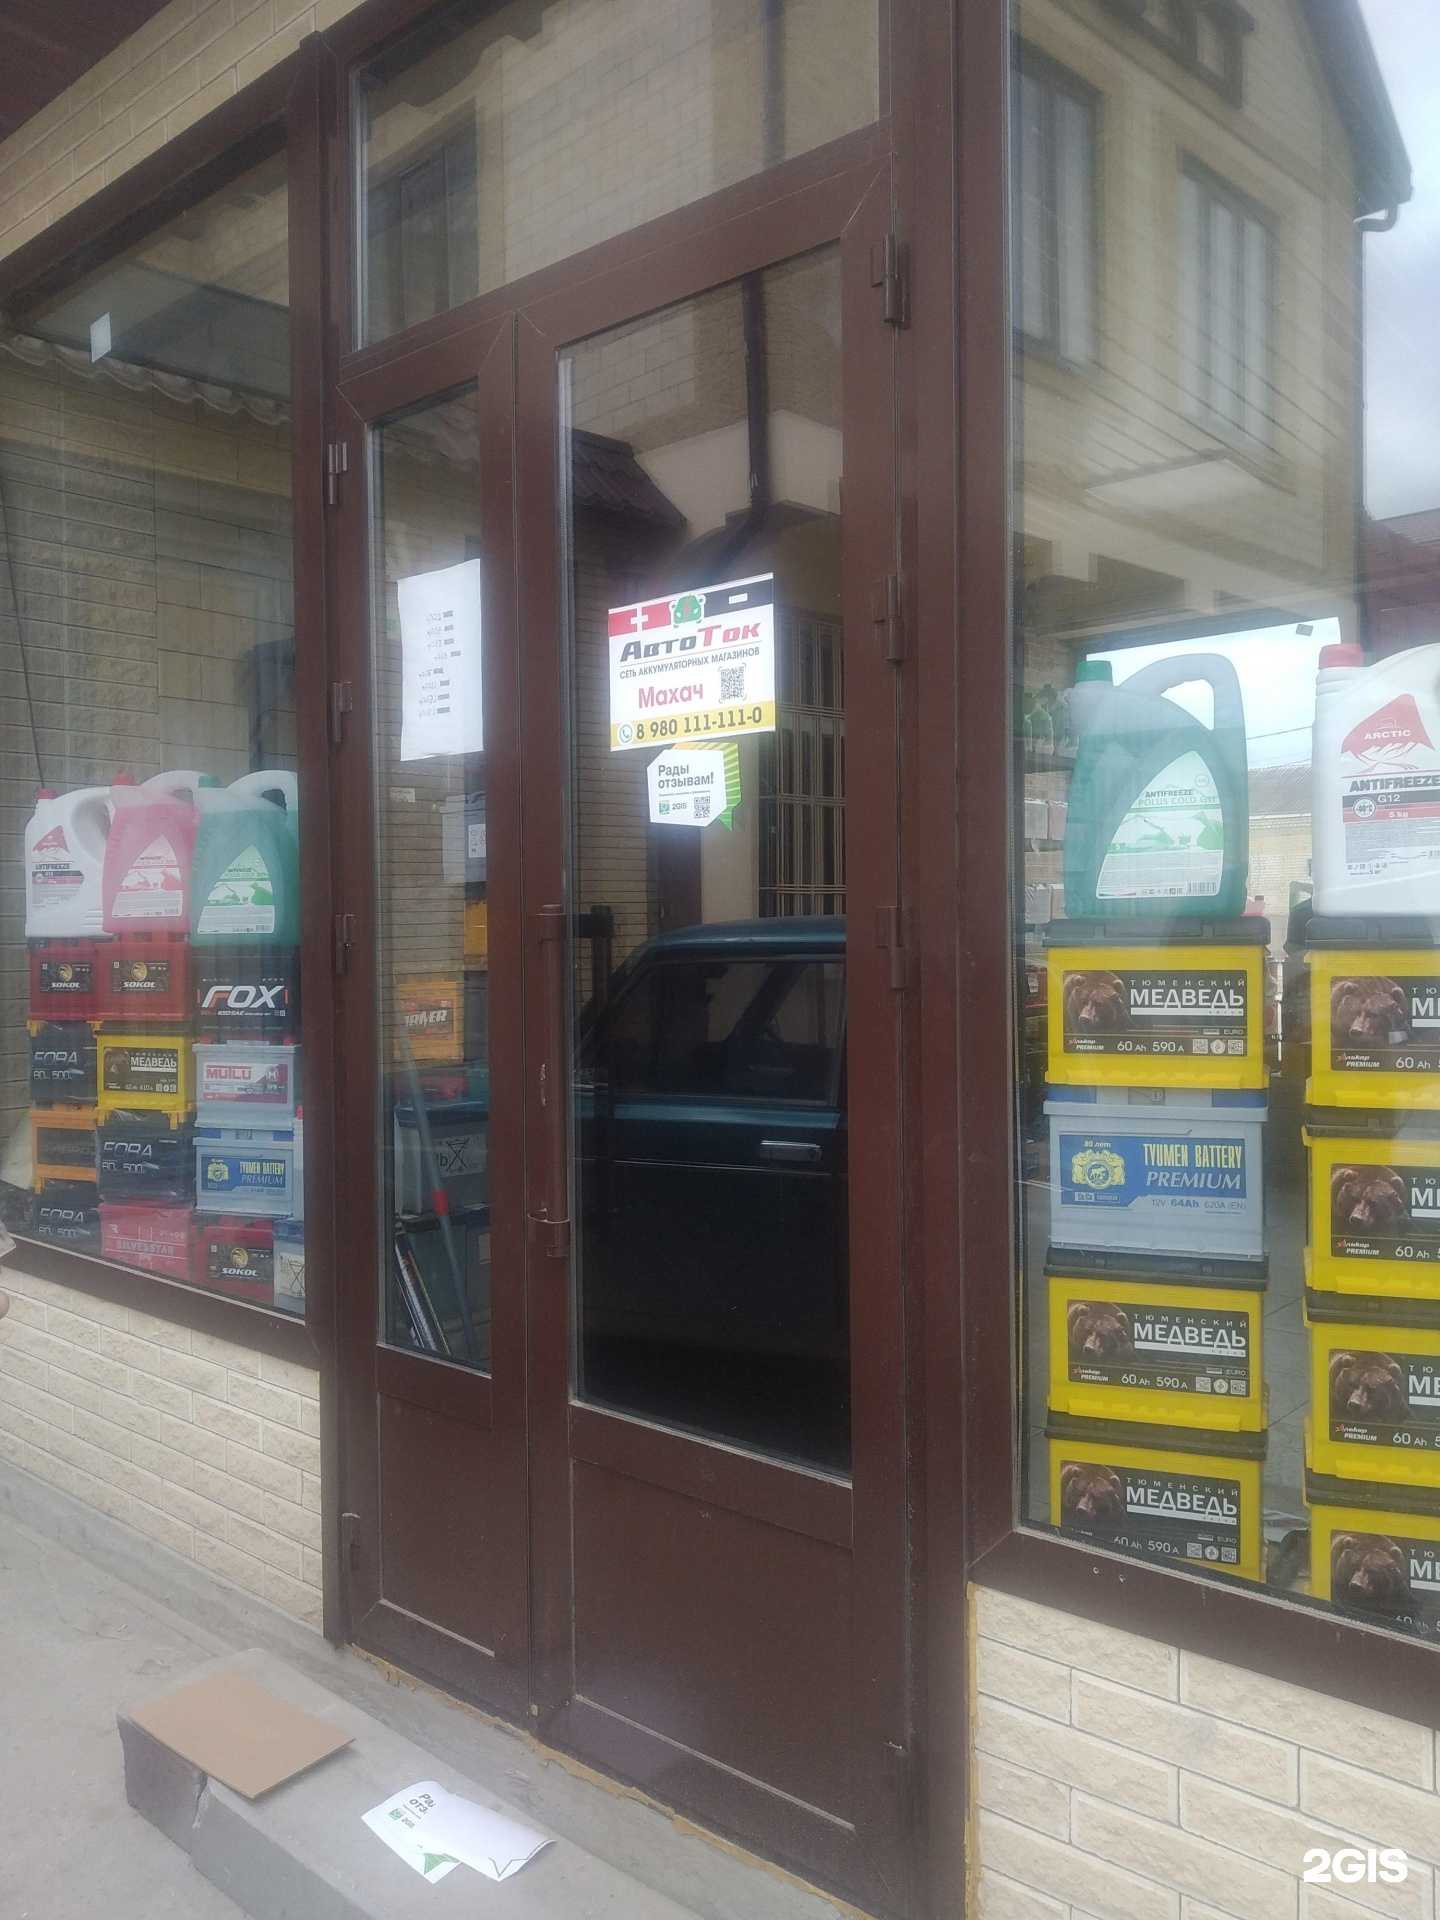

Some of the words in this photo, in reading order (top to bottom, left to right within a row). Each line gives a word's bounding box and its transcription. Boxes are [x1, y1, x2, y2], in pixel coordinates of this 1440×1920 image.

[619, 668, 637, 680] СЕТЬ
[638, 657, 709, 677] АККУМУЛЯТОРНЫХ
[710, 646, 760, 664] МАГАЗИНОВ
[638, 683, 704, 709] Махач
[636, 724, 645, 740] 8
[650, 719, 678, 737] 980
[684, 706, 762, 733] 111-111-0
[1364, 729, 1412, 740] ARCTIC
[658, 764, 689, 777] Рады
[658, 772, 714, 789] отзывам!
[1145, 789, 1193, 798] ANTIFREEZE
[1377, 794, 1401, 803] G12
[51, 981, 80, 989] SOKOL
[122, 981, 156, 989] SOKOL
[1129, 977, 1245, 987] ТЮМЕНСКИЙ
[201, 985, 285, 1008] FOX
[1130, 988, 1244, 1009] МЕДВЕДЬ
[1117, 1040, 1133, 1051] 60
[1135, 1043, 1147, 1052] Ah
[1152, 1041, 1176, 1052] 590
[130, 1056, 177, 1068] МЕДВЕДЬ
[1346, 1060, 1380, 1068] PREMIUM
[1395, 1056, 1415, 1069] 60
[1416, 1059, 1431, 1070] Ah
[1143, 1143, 1189, 1167] TYUMEN
[1195, 1145, 1242, 1169] BATTERY
[1145, 1171, 1241, 1190] PREMIUM
[1171, 1199, 1200, 1209] 64Ah
[1346, 1248, 1380, 1256] PREMIUM
[1395, 1245, 1414, 1258] 60
[1416, 1249, 1430, 1259] Ah
[221, 1267, 259, 1277] SOKOL
[1134, 1313, 1247, 1329] ТЮМЕНСКИЙ
[1133, 1322, 1246, 1349] МЕДВЕДЬ
[1120, 1374, 1137, 1385] 60
[1138, 1377, 1151, 1386] Ah
[1156, 1376, 1180, 1389] 590
[1344, 1432, 1378, 1442] PREMIUM
[1393, 1432, 1411, 1445] 60
[1414, 1436, 1428, 1447] Ah
[1126, 1477, 1238, 1497] ТЮМЕНСКИЙ
[1126, 1485, 1238, 1516] МЕДВЕДЬ
[1130, 1539, 1143, 1550] Ah
[1148, 1540, 1171, 1553] 590
